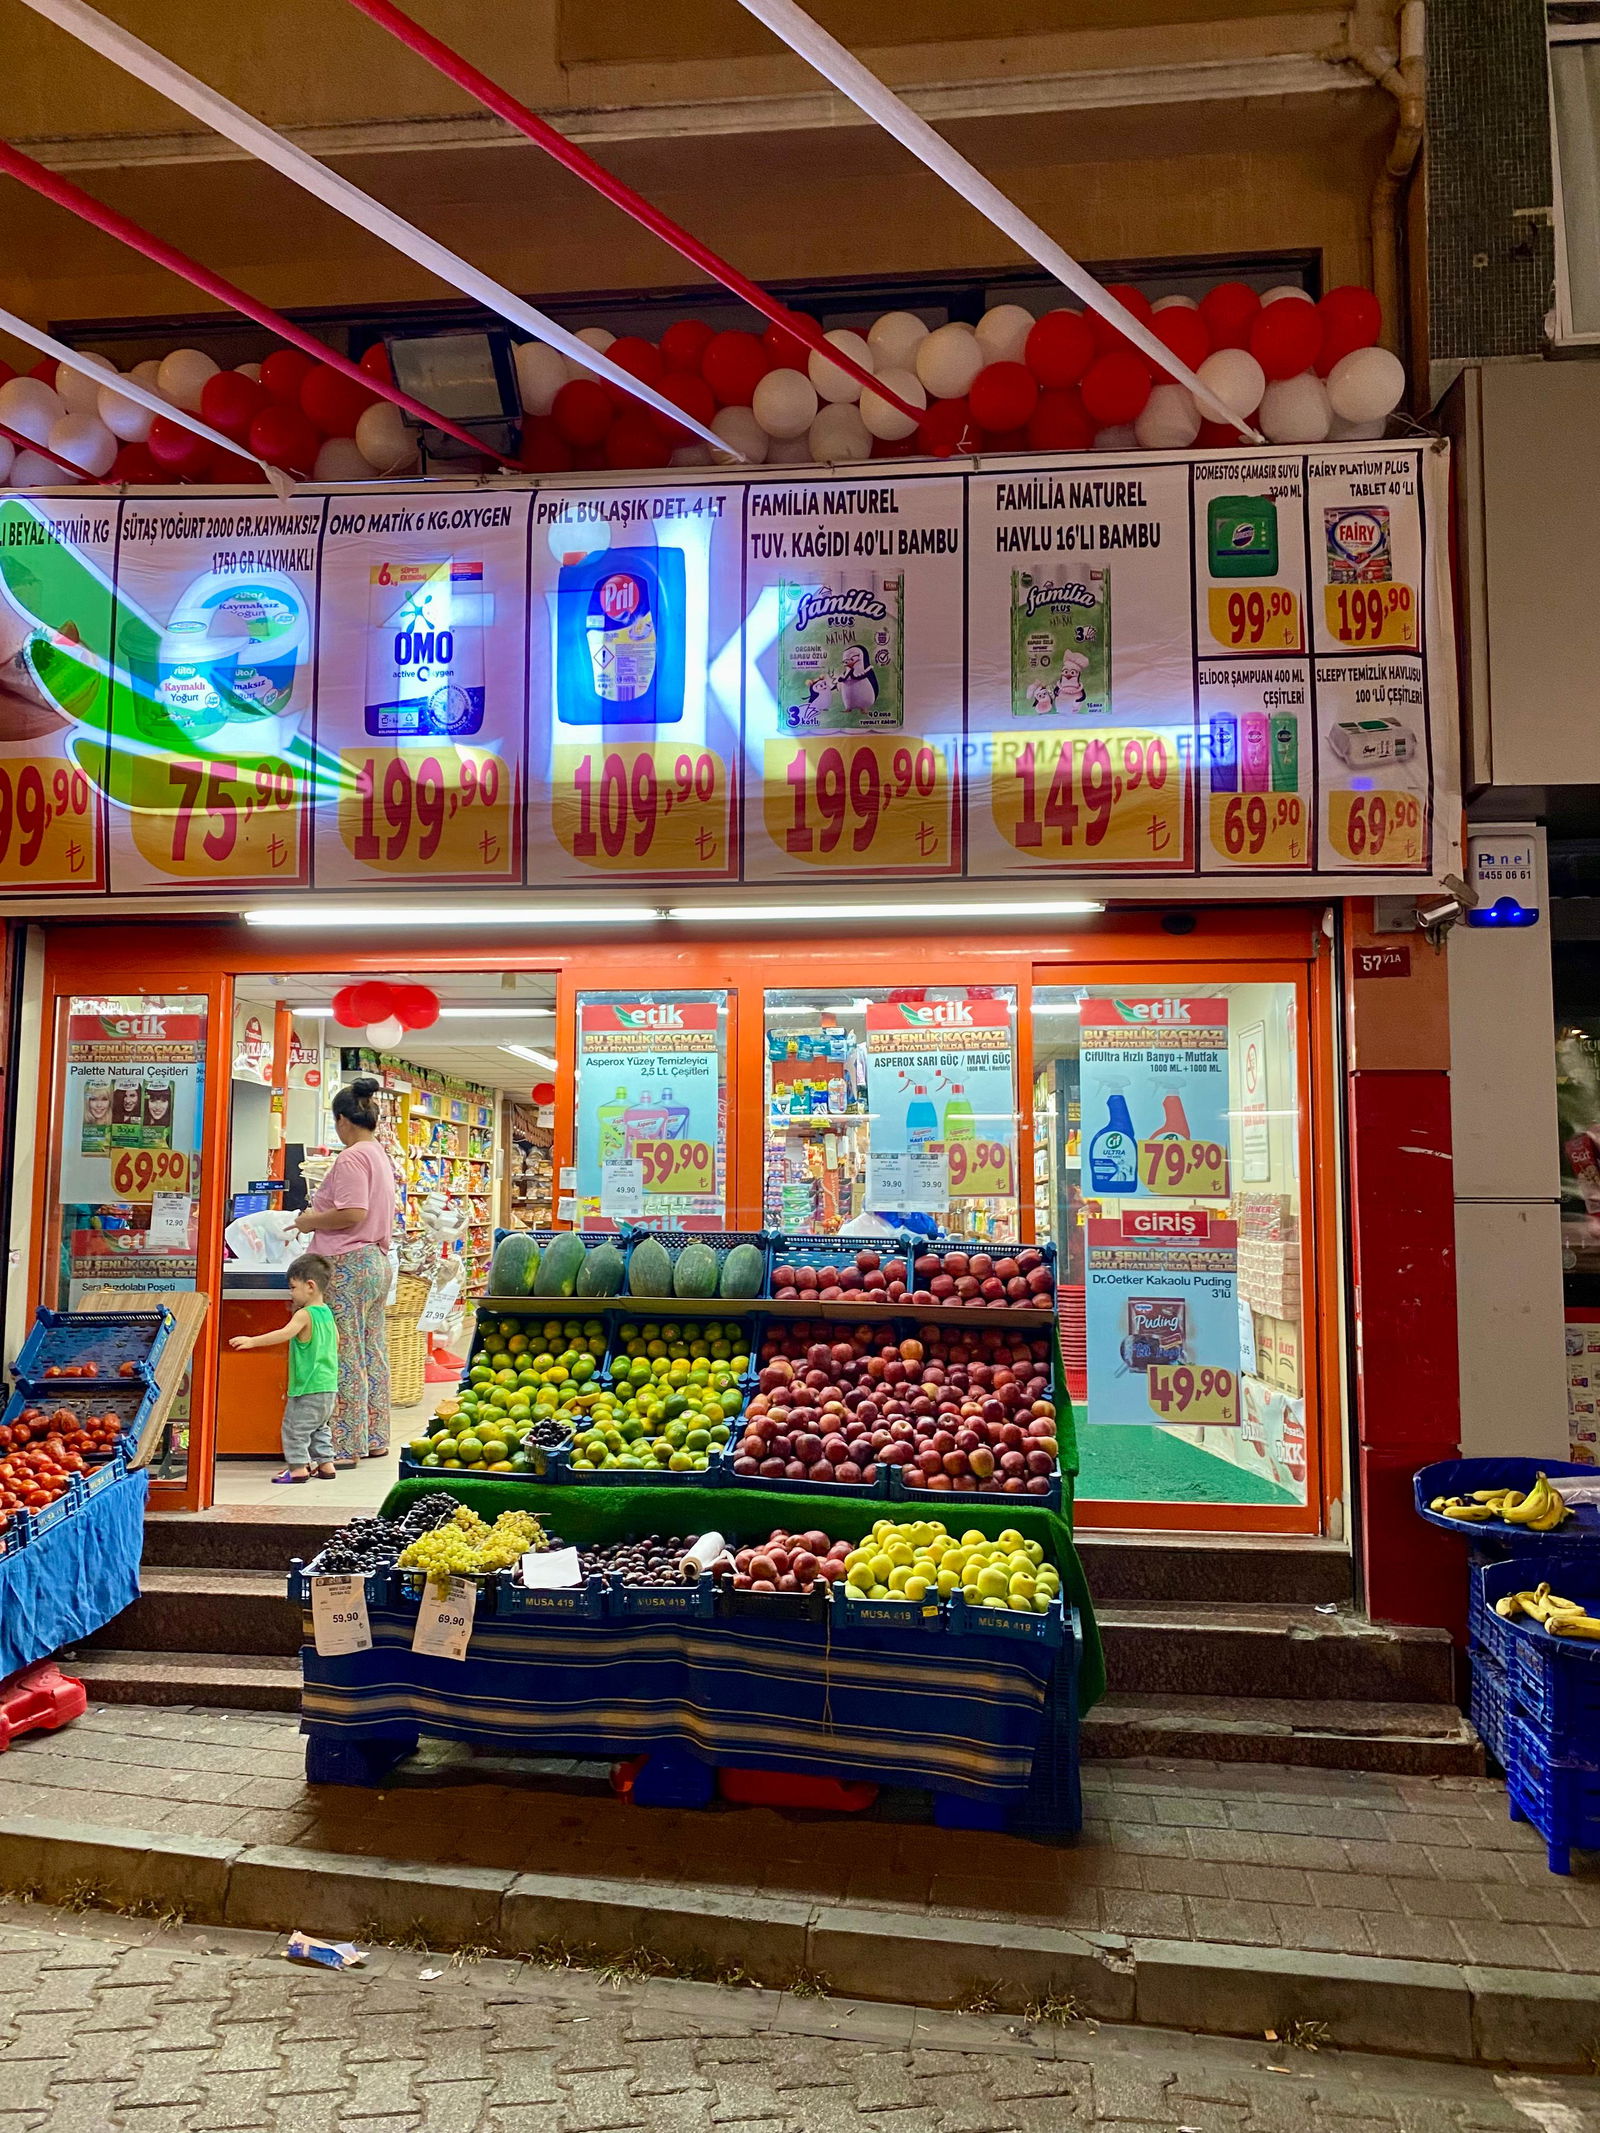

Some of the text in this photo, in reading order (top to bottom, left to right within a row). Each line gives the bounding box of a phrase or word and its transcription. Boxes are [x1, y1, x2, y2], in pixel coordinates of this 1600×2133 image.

[1195, 465, 1239, 480] DOMESTOS
[1278, 465, 1299, 478] SUYU
[1309, 461, 1409, 477] FAİRY PLATİUM PLUS
[996, 478, 1147, 510] FAMİLİA NATUREL
[1290, 485, 1302, 498] ML
[1350, 483, 1386, 497] TABLET
[1389, 482, 1400, 495] 40
[537, 496, 726, 528] PRİL BULAŞIK DET. 4 LT
[752, 489, 898, 516] FAMİLİA NATUREL
[9, 513, 109, 546] BEYAZ PEYNİR KG
[122, 511, 320, 546] SÜTAŞ YOĞURT 2000 GR.KAYMAKSIZ
[330, 507, 511, 534] OMO MATİK 6 KG.OXYGEN
[752, 525, 958, 558] TUV. KAĞIDI 40'LI BAMBU
[997, 522, 1161, 552] HAVLU 16'LI BAMBU
[212, 548, 314, 575] 1750 GR KAYMAKLI
[378, 563, 391, 586] 6
[605, 582, 634, 612] Pril
[1026, 582, 1095, 617] familia
[796, 589, 886, 631] familia
[1051, 605, 1070, 613] PLUS
[1228, 592, 1292, 644] 99,90
[1338, 587, 1410, 640] 199,90
[828, 617, 855, 626] PLUS
[395, 632, 453, 664] OMO
[393, 666, 454, 681] active Oygen
[1200, 668, 1305, 687] ELİDOR ŞAMPUAN 400 ML
[1317, 670, 1346, 683] SLEEPY
[1348, 664, 1387, 682] TEMİZLİK
[165, 682, 206, 692] Kaymaklı
[1355, 689, 1371, 703] 100
[1387, 686, 1423, 707] ÇEŞİTLERİ
[171, 694, 199, 704] Yoğurt
[1263, 688, 1305, 708] ÇEŞİTLERİ
[786, 746, 936, 853] 199,90
[1015, 740, 1168, 847] 149,90
[169, 760, 294, 862] 75,90
[354, 757, 499, 861] 199,90
[573, 753, 714, 857] 109,90
[1225, 796, 1300, 854] 69,90
[1348, 797, 1417, 855] 69,90
[1478, 849, 1530, 869] Panel
[1362, 954, 1383, 971] 57
[630, 1005, 684, 1024] etik
[918, 1002, 973, 1022] etik
[1132, 999, 1191, 1019] etik
[116, 1016, 167, 1034] etik
[1084, 1027, 1224, 1041] BU ŞENLİK KAÇMAZ!
[586, 1032, 713, 1046] BU ŞENLİK KAÇMAZ!
[870, 1029, 1005, 1045] BU ŞENLİK KAÇMAZ!
[72, 1042, 193, 1055] BU ŞENLİK KAÇMAZ!
[1123, 1052, 1143, 1062] Hızlı
[1147, 1052, 1174, 1064] Banyo
[1185, 1051, 1218, 1063] Mutfak
[586, 1056, 708, 1068] Asperox Yüzey Temizleyici
[874, 1056, 915, 1067] ASPEROX
[917, 1056, 938, 1067] SARI
[940, 1055, 959, 1068] GÜÇ
[967, 1053, 990, 1066] MAVİ
[992, 1052, 1011, 1066] GÜÇ
[70, 1066, 188, 1078] Palette Natural Çeşitleri
[641, 1067, 655, 1076] 2,5
[671, 1067, 709, 1078] Çeşitleri
[1106, 1134, 1122, 1149] Cif
[114, 1152, 184, 1193] 69,90
[1144, 1143, 1222, 1186] 79,90
[1134, 1213, 1196, 1235] GİRİŞ
[1092, 1251, 1111, 1261] BU
[1115, 1249, 1165, 1264] ŞENLİK
[82, 1283, 101, 1292] Sera
[148, 1283, 176, 1293] Poşeti
[1092, 1274, 1232, 1289] Dr.Oetker Kakaolu Puding
[1212, 1288, 1231, 1299] 3'lü
[1134, 1314, 1179, 1331] Puding
[1150, 1366, 1232, 1412] 49,90
[525, 1597, 574, 1607] MUSA 419
[332, 1611, 359, 1623] 59.90
[438, 1614, 465, 1627] 69.90
[860, 1609, 890, 1620] MUSA
[978, 1617, 1009, 1629] MUSA
